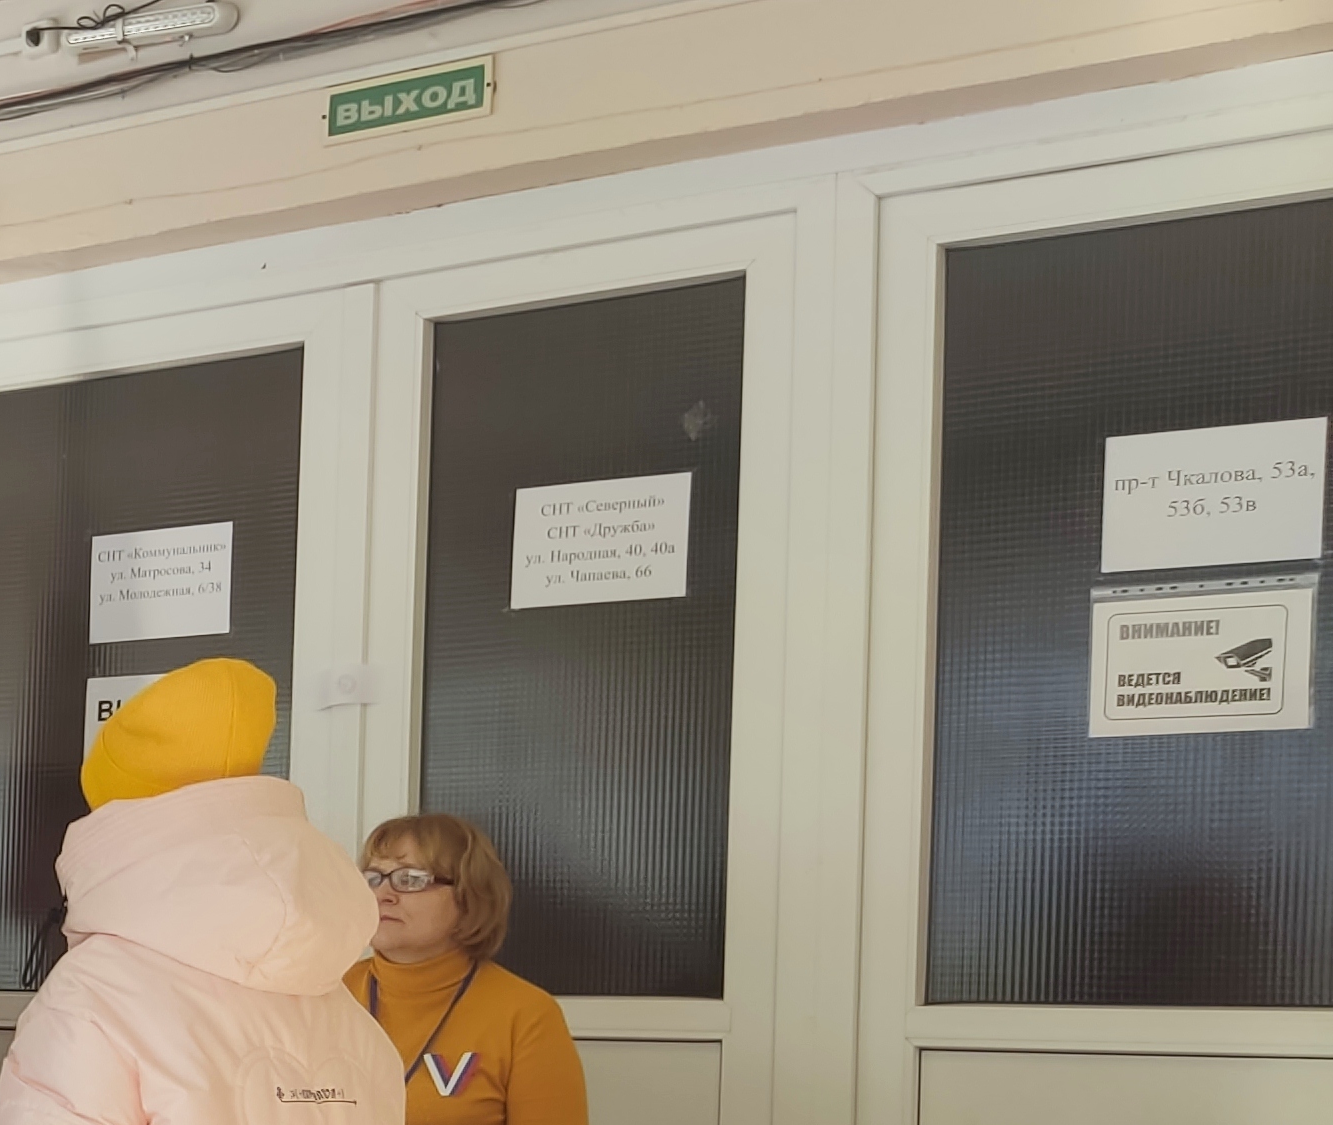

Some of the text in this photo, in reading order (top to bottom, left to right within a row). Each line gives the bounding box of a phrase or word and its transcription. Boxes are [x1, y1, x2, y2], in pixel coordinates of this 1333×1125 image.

[336, 78, 476, 127] ВЫХОД
[1114, 460, 1315, 495] пр-т Чкалова, 53а,
[541, 495, 665, 517] СНТ «Северный»
[1166, 496, 1257, 518] 53б, 53в
[547, 520, 656, 540] СНТ «Дружба»
[97, 543, 227, 563] СНТ «Коммунальник»
[525, 553, 546, 567] ул.
[550, 548, 622, 565] Народная,
[650, 541, 676, 556] 40а
[110, 569, 127, 583] ул.
[130, 564, 195, 580] Матросова,
[545, 565, 652, 588] ул. Чапаева, 66
[98, 582, 222, 605] ул. Молодежная, 6/38
[1119, 619, 1221, 640] ВНИМАНИЕ!
[1117, 671, 1181, 689] ВЕДЕТСЯ
[1116, 687, 1272, 708] ВИДЕОНАБЛЮДЕНИЕ!
